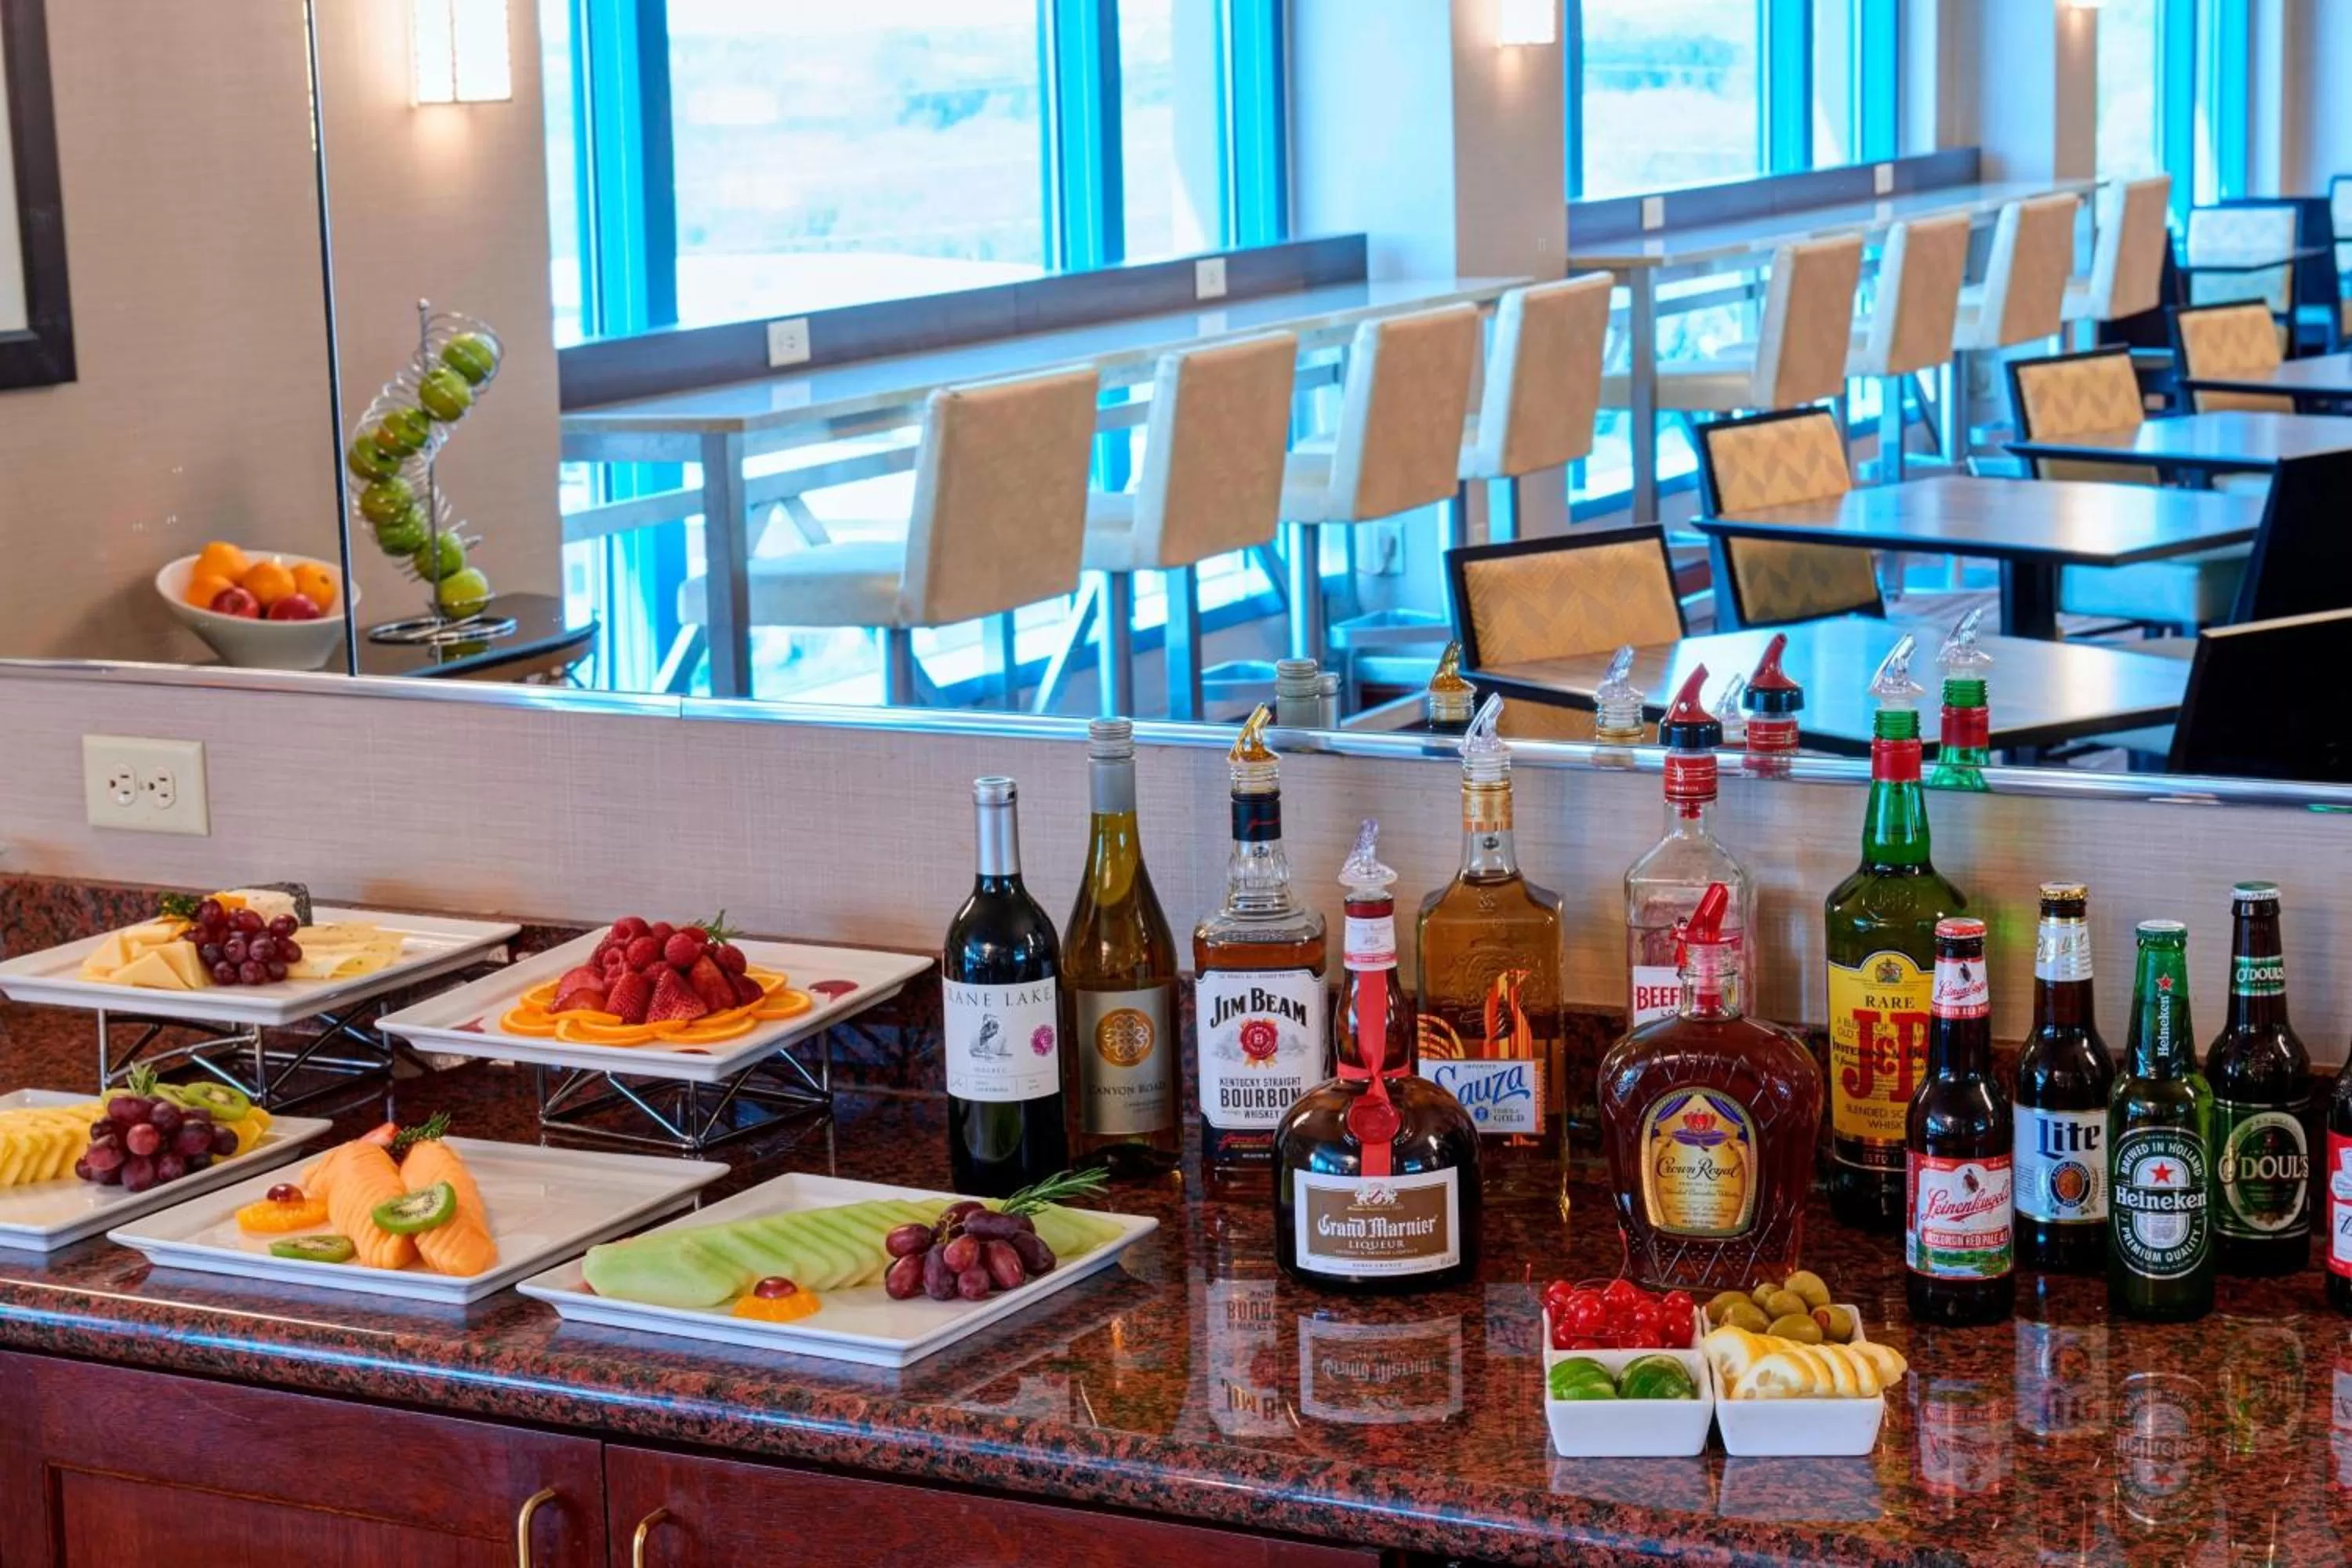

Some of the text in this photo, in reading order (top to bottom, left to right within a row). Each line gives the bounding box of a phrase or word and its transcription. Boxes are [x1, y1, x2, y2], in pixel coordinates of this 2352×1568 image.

[1004, 985, 1053, 1007] LAKE
[1210, 987, 1308, 1028] JIM BEAM
[1865, 994, 1915, 1009] RARE
[2158, 995, 2170, 1057] Heineken
[1219, 1076, 1302, 1087] KENTUCKY STRAIGHT
[1434, 1065, 1531, 1106] Sauza
[1220, 1087, 1301, 1108] BOURBON
[1243, 1109, 1280, 1120] WHISKEY
[1869, 1119, 1904, 1130] WHISK
[2035, 1116, 2100, 1161] Lite
[1657, 1156, 1742, 1181] Crown Royal
[2121, 1142, 2202, 1176] BREWED IN HOLLAND
[2116, 1185, 2207, 1210] Heineken
[1318, 1213, 1437, 1239] Grand Marnier
[1348, 1240, 1405, 1250] LIQUEUR
[2121, 1226, 2201, 1262] PREMIUM QUALITY
